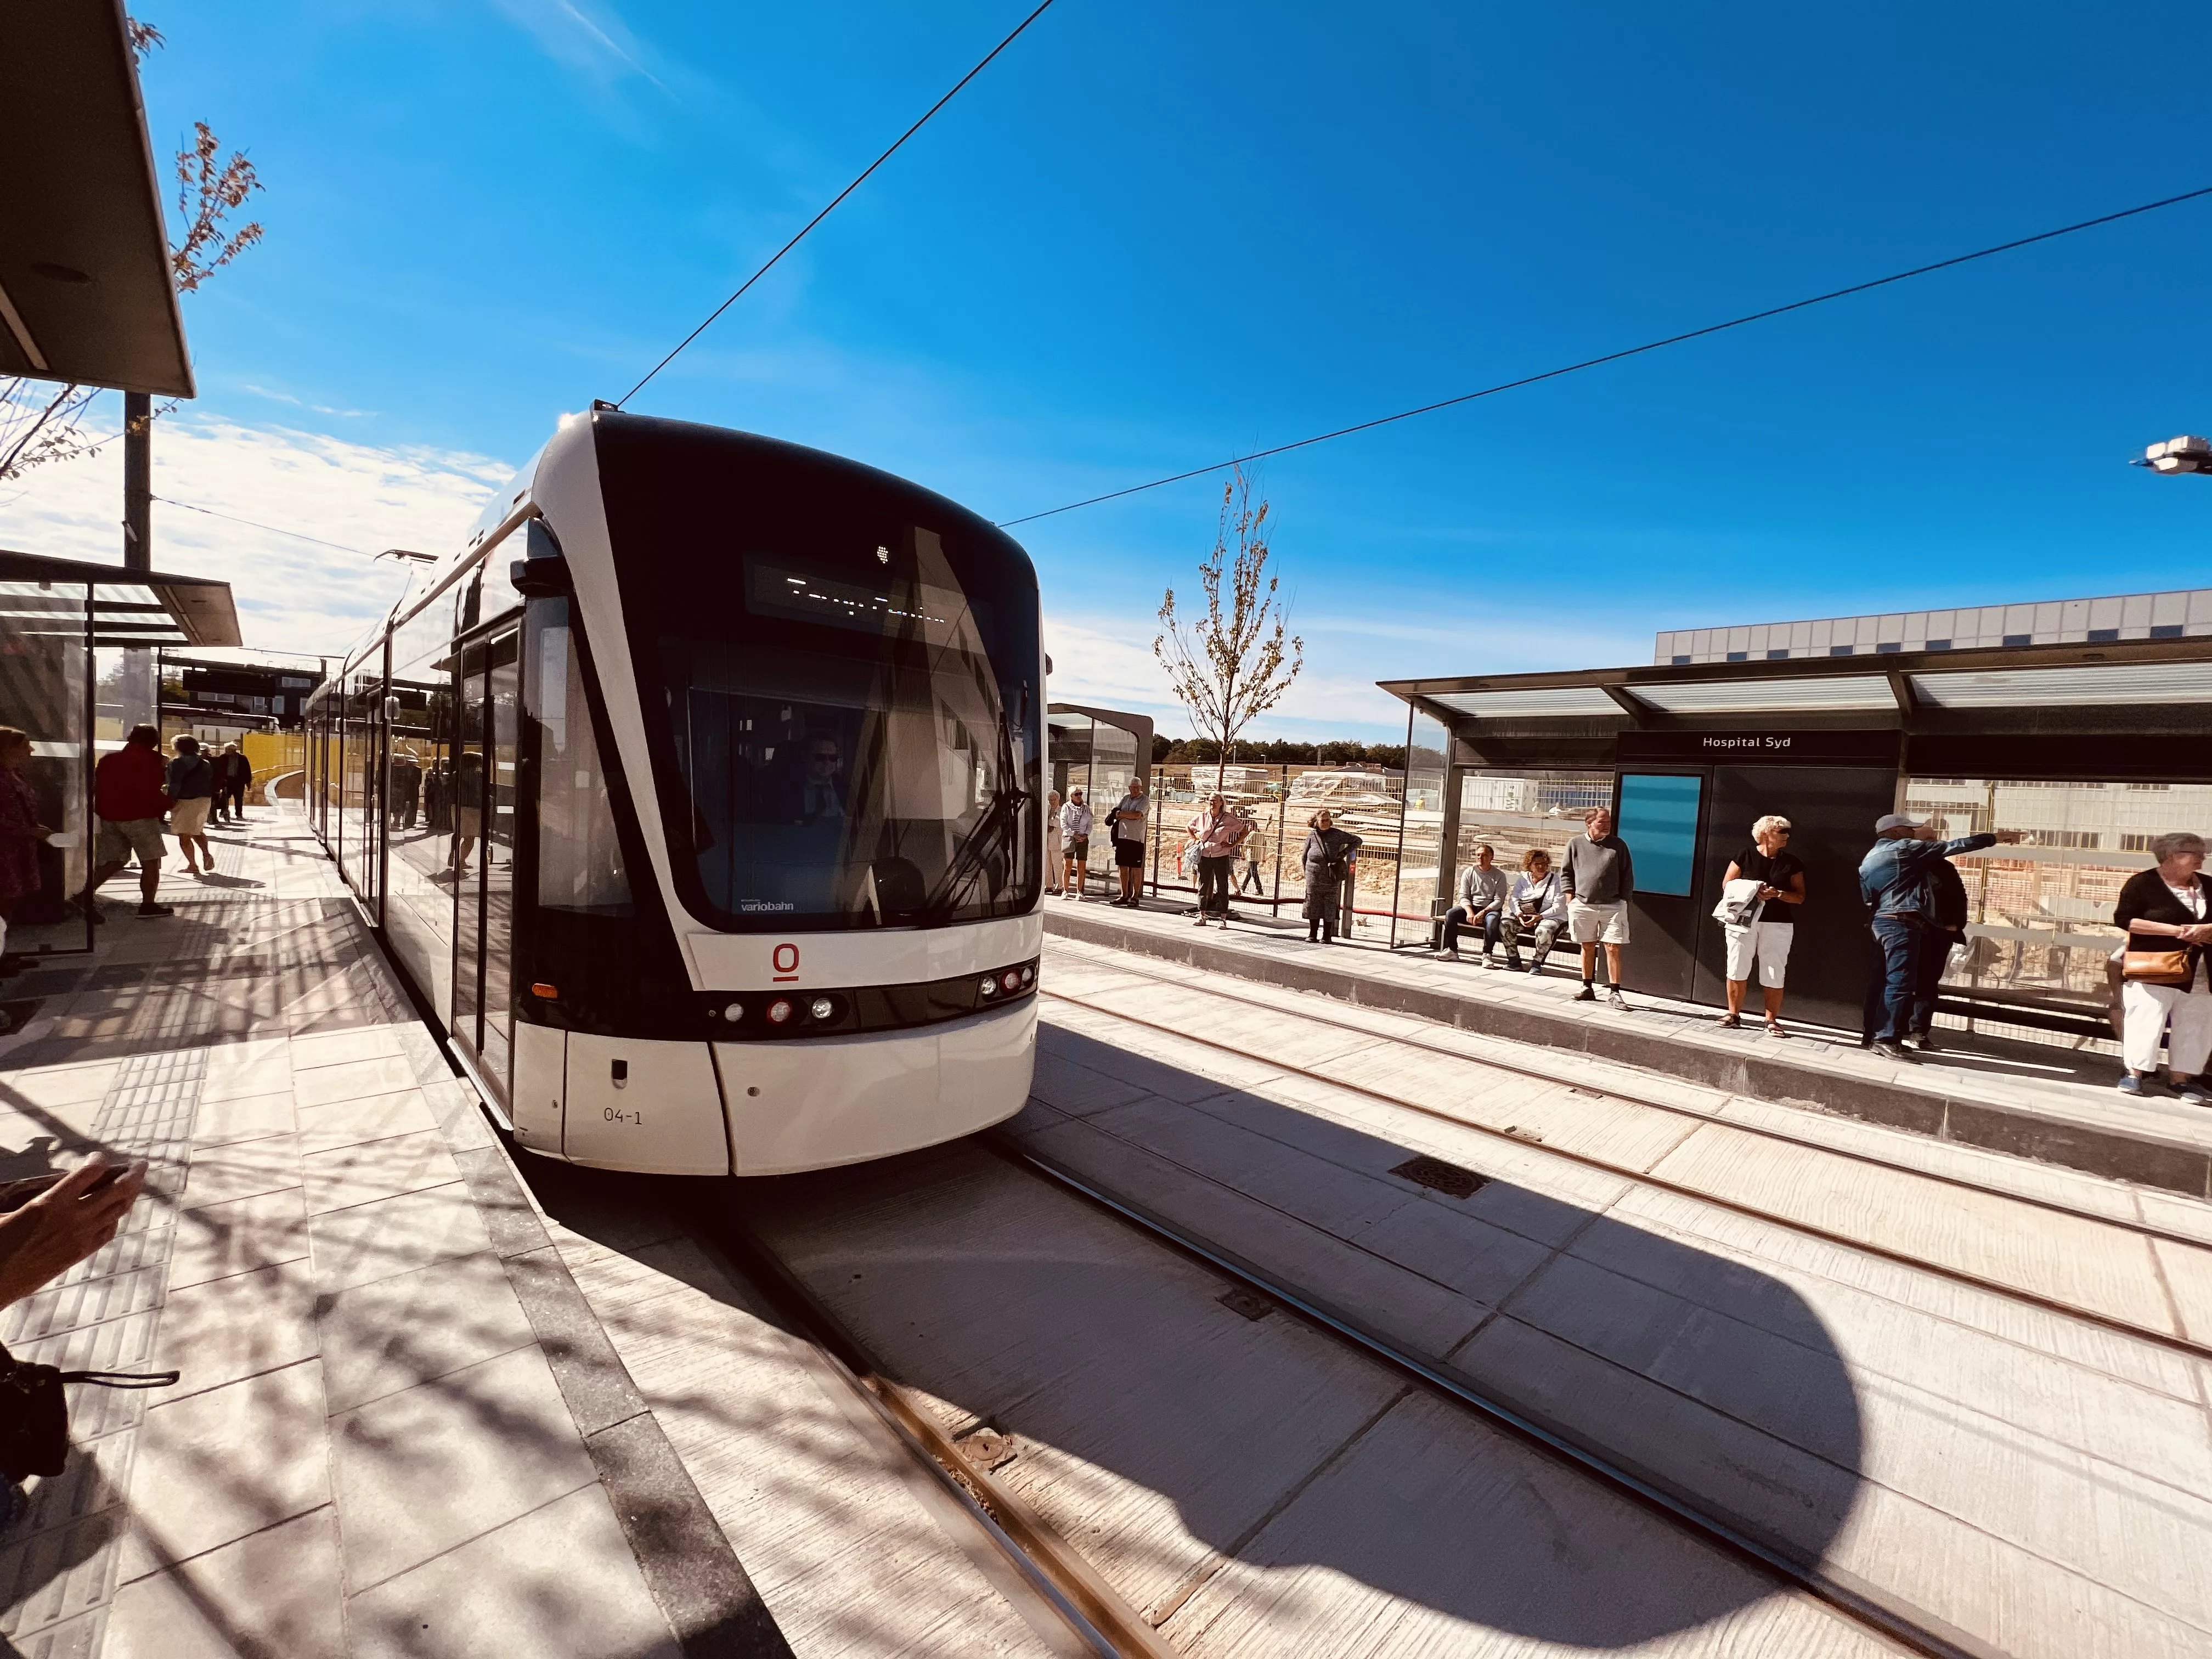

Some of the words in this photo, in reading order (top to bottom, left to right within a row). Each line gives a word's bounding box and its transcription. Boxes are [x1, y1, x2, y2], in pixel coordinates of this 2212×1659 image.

[1703, 737, 1760, 749] Hospital
[1765, 737, 1791, 749] Syd
[741, 901, 794, 911] variobahn
[604, 1107, 642, 1125] 04-1
